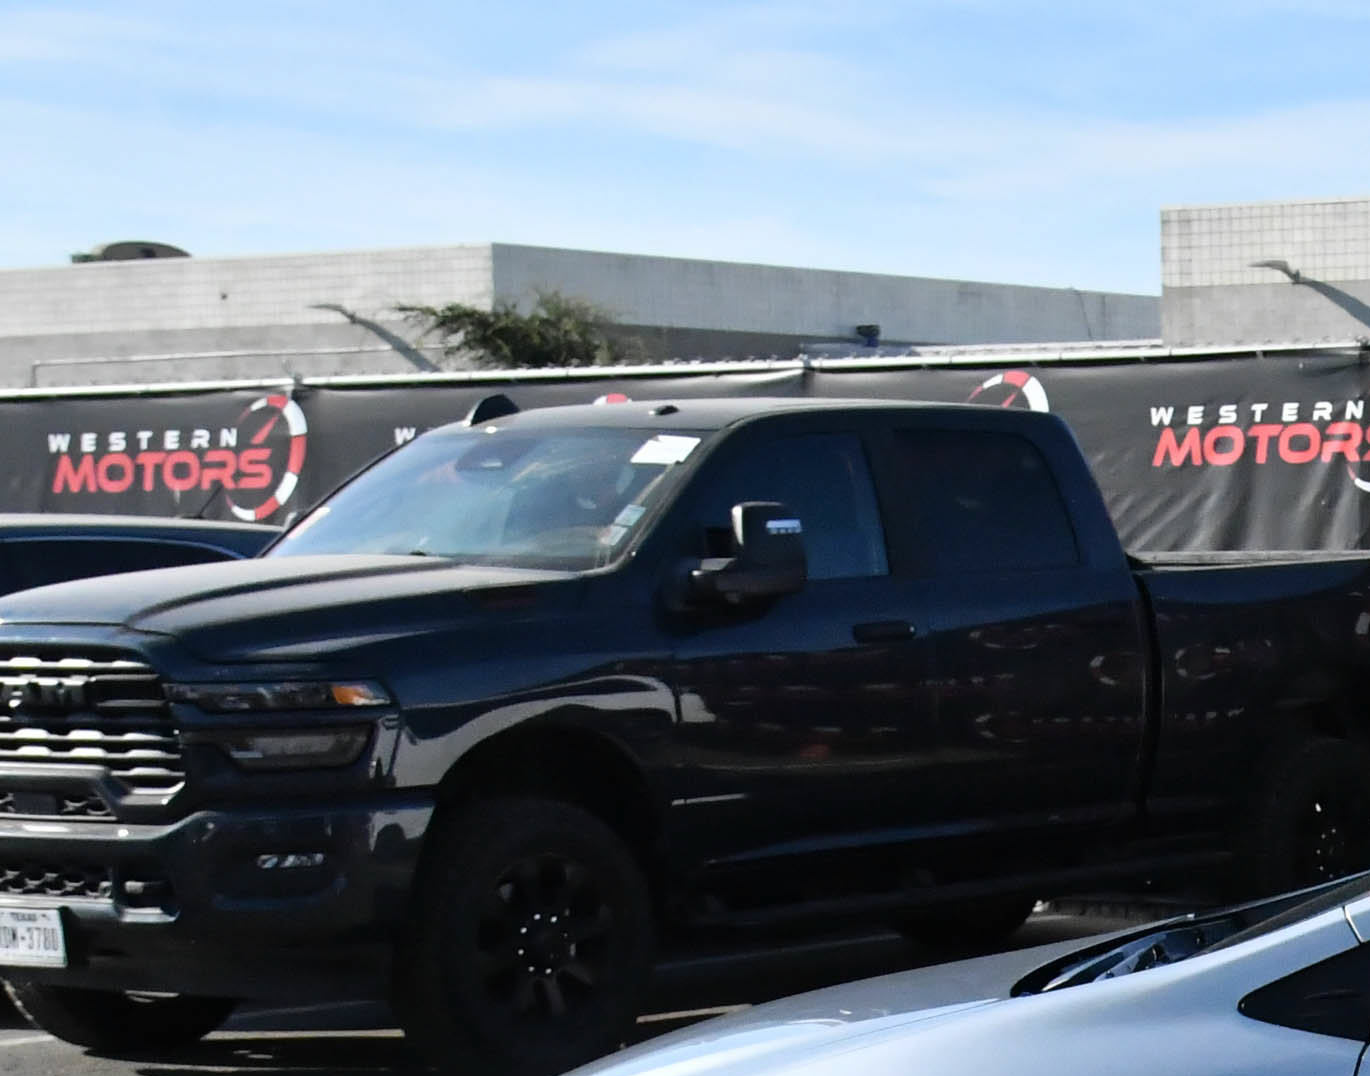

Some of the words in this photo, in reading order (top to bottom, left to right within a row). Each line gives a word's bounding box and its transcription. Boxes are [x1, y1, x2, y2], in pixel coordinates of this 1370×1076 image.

[1149, 399, 1365, 427] WESTERN
[47, 427, 238, 453] WESTERN
[53, 447, 271, 493] MOTORS
